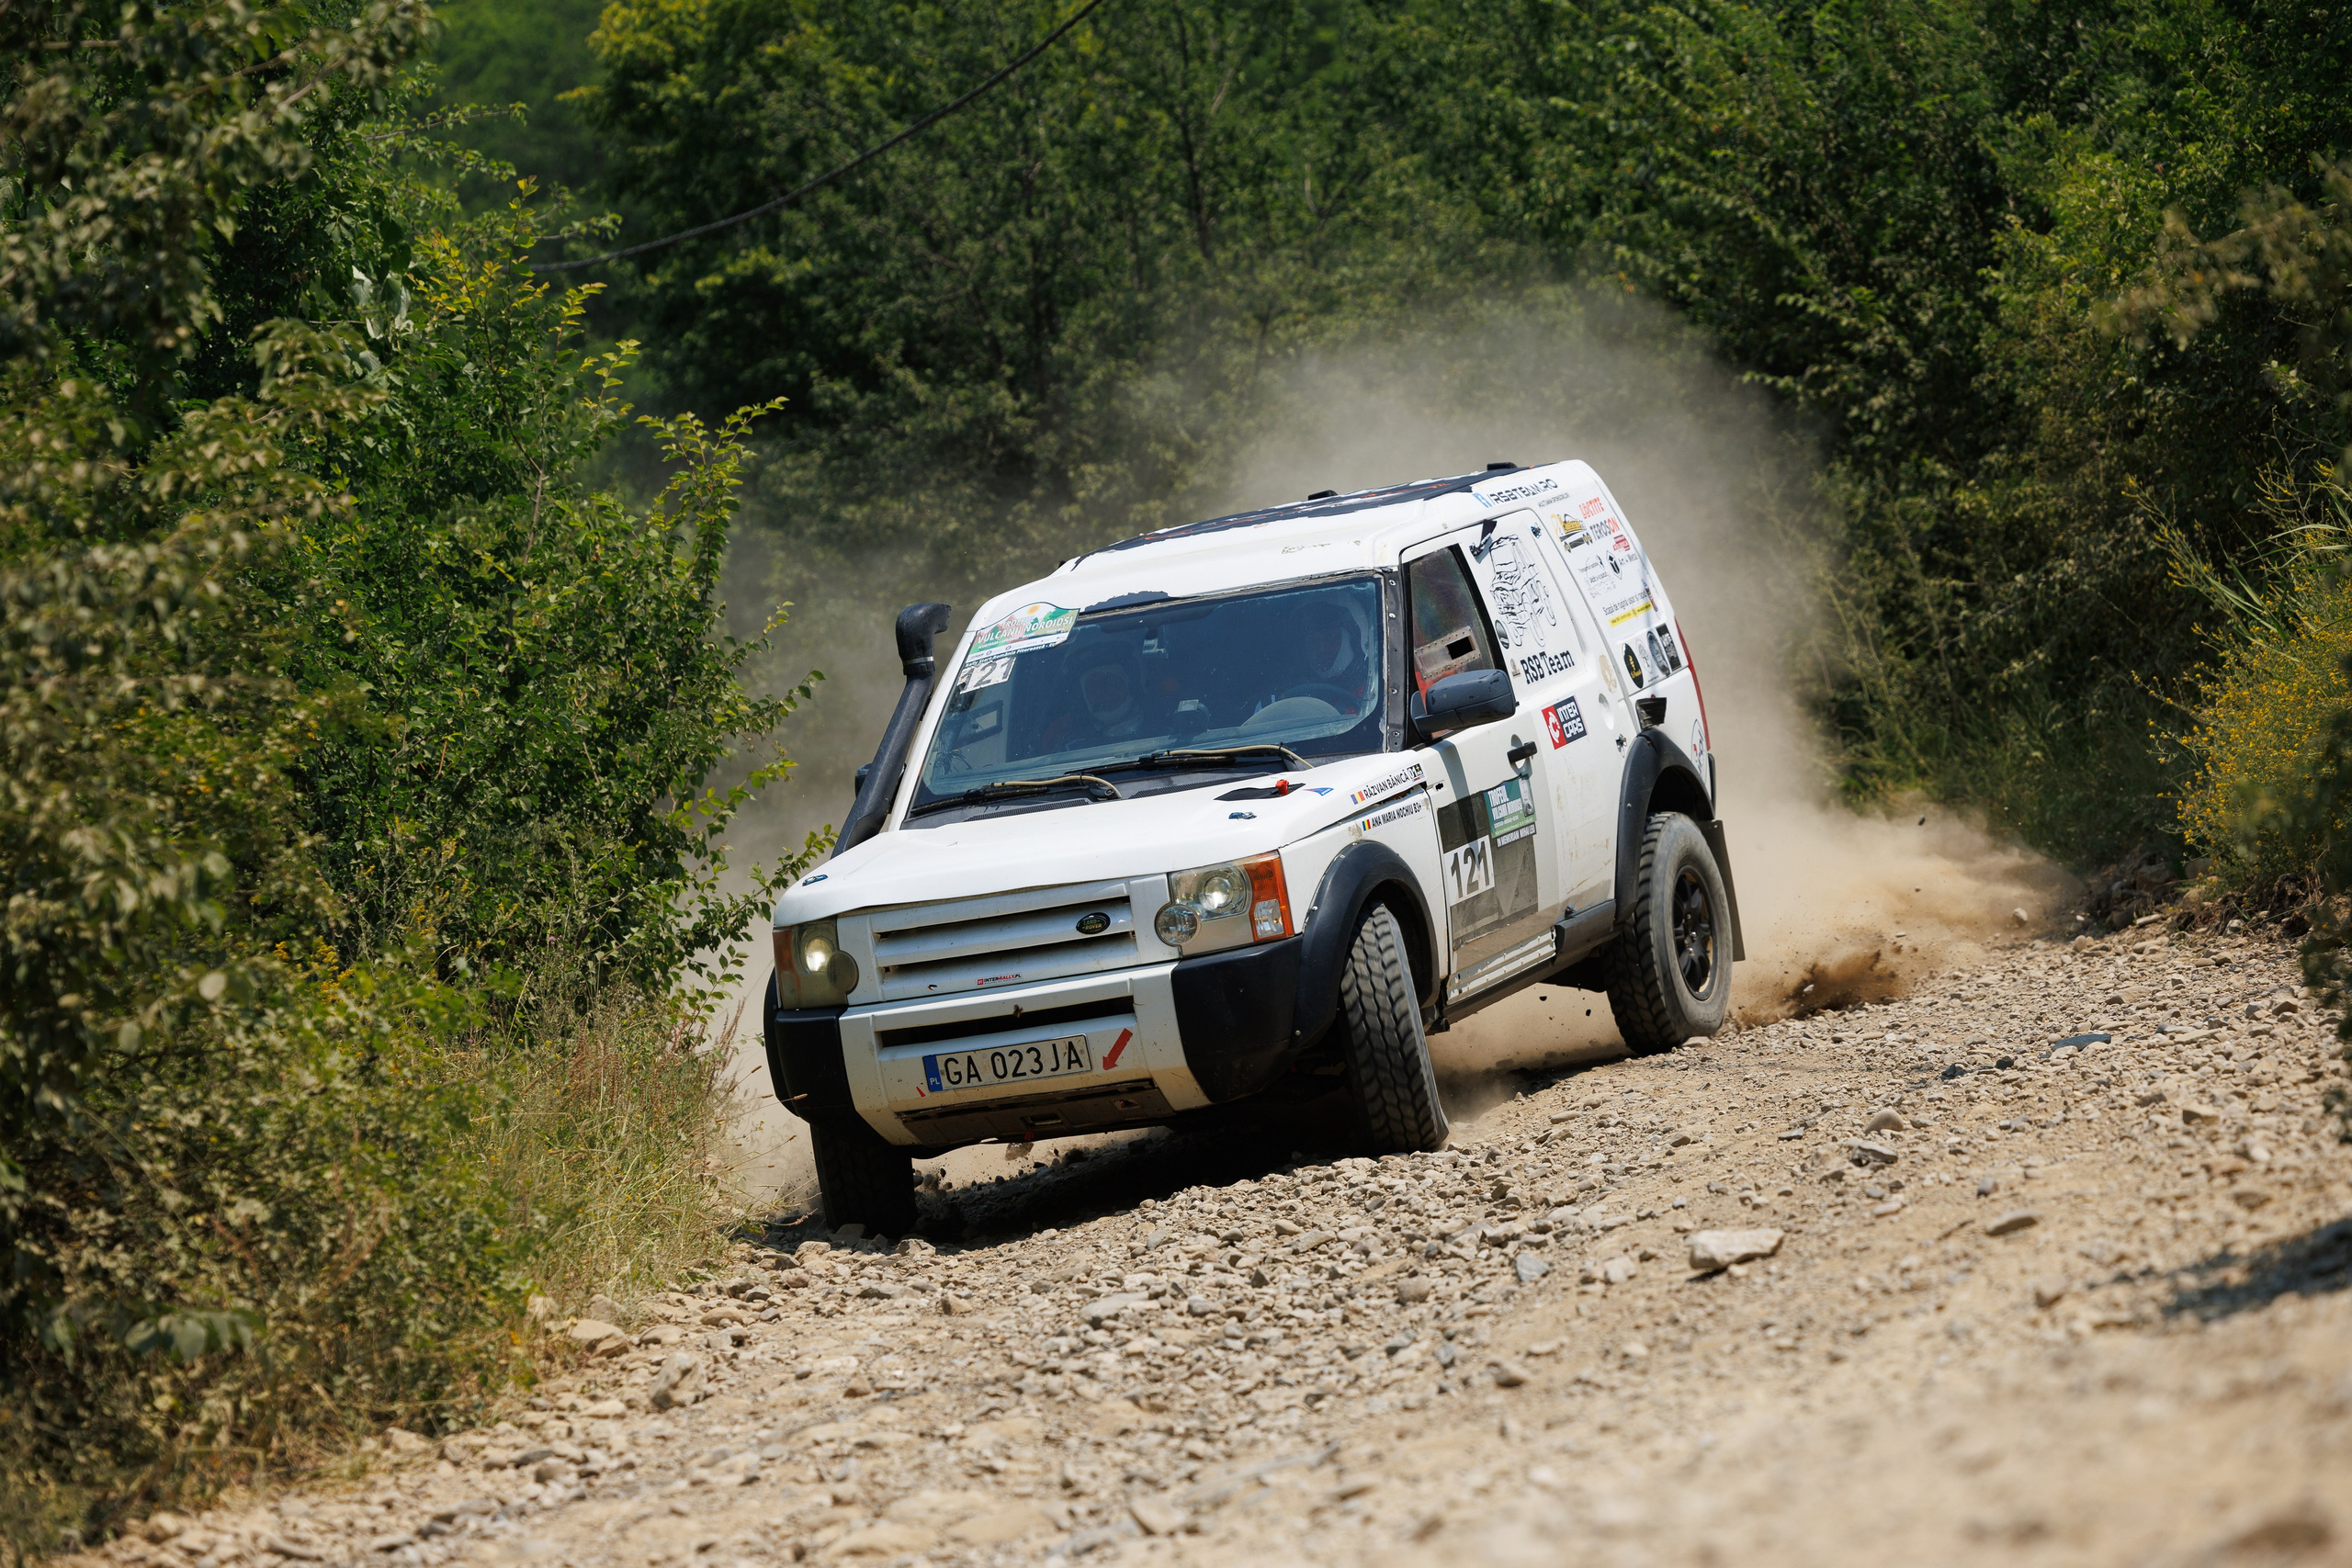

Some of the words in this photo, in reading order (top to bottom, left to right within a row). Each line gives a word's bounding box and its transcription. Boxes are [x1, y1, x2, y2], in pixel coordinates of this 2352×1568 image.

[1578, 497, 1604, 519] LOCTITE
[1589, 516, 1620, 540] TEROSON
[978, 626, 1022, 644] VULCANII
[1023, 615, 1074, 633] NOROIOȘI
[1520, 654, 1544, 684] RSB
[1539, 650, 1575, 675] Team
[1556, 701, 1578, 723] INTER
[1563, 717, 1584, 739] CARS
[1363, 781, 1389, 799] RĂZVAN
[1386, 769, 1409, 789] BĂNICĂ
[1372, 816, 1382, 829] ANA
[1382, 810, 1396, 824] MARIA
[1451, 840, 1489, 898] 121
[930, 1077, 940, 1086] PL
[944, 1055, 982, 1086] GA
